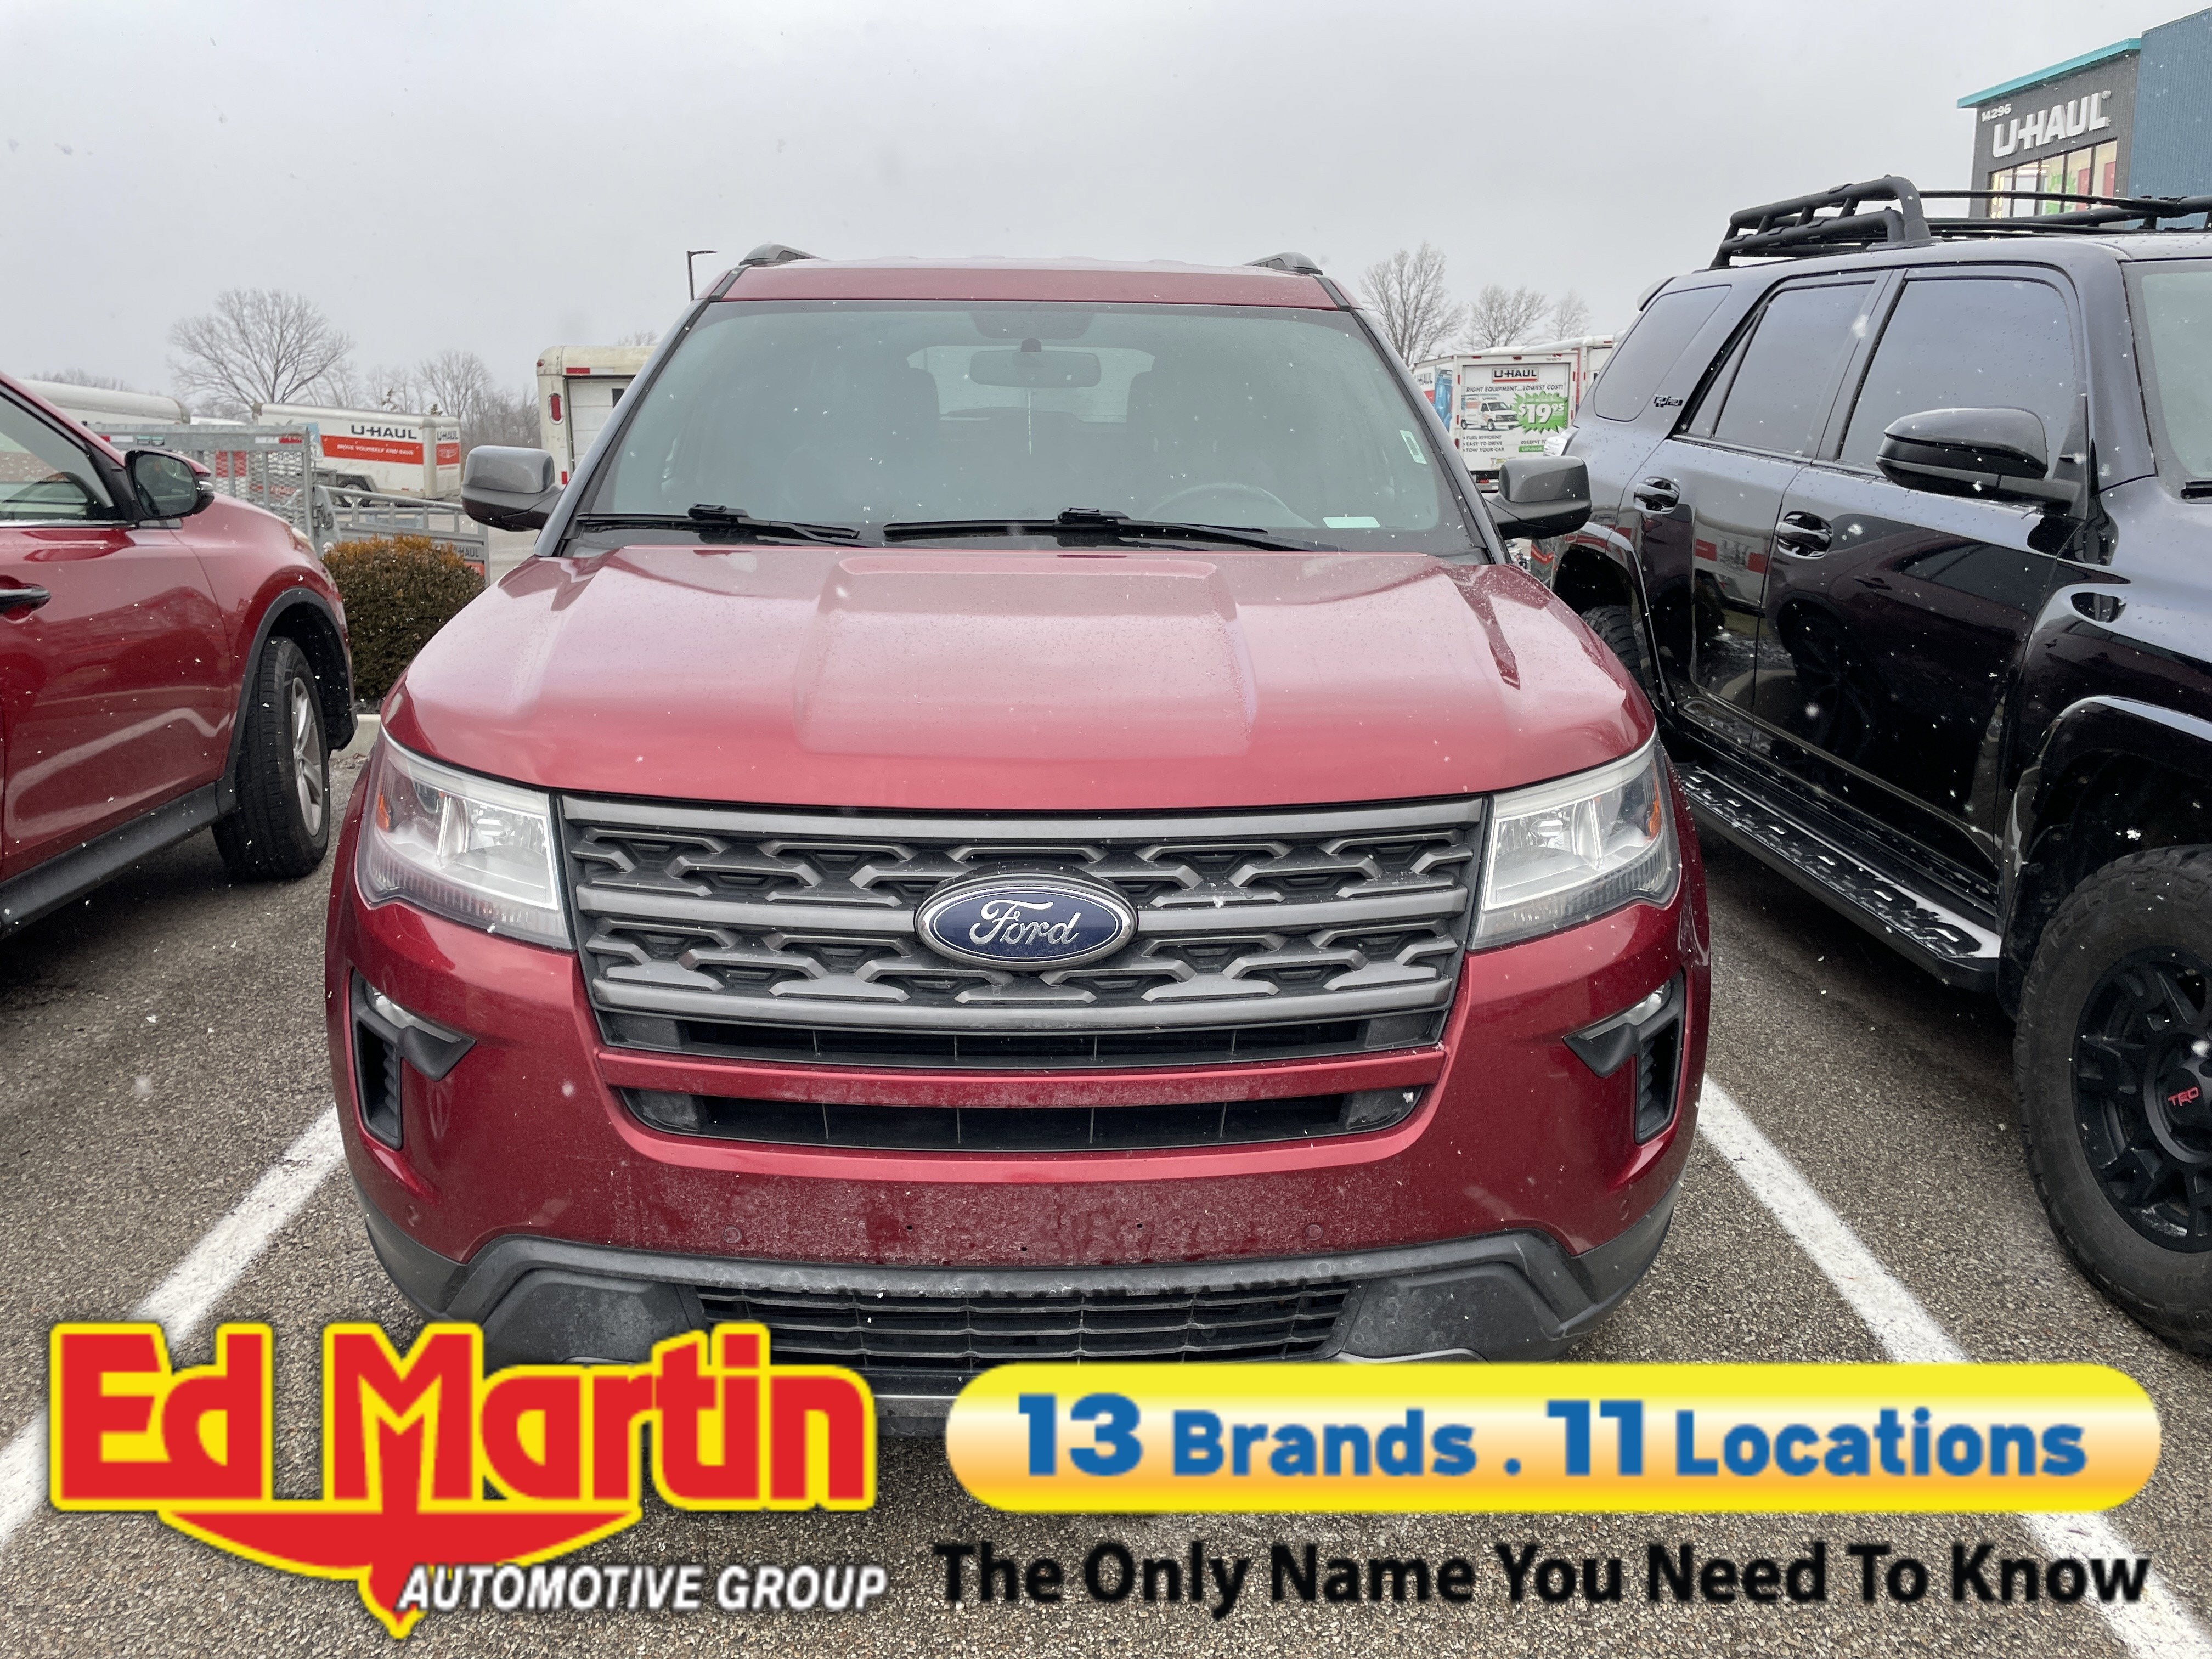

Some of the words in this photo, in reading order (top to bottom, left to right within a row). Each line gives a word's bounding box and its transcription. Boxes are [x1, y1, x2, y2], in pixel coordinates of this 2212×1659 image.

[1981, 103, 2012, 122] 14296
[1993, 93, 2109, 157] U-HAUL
[1493, 369, 1537, 377] U-HAUL
[351, 424, 417, 439] U-HAUL
[969, 899, 1082, 945] Ford
[2168, 1087, 2199, 1107] TRD
